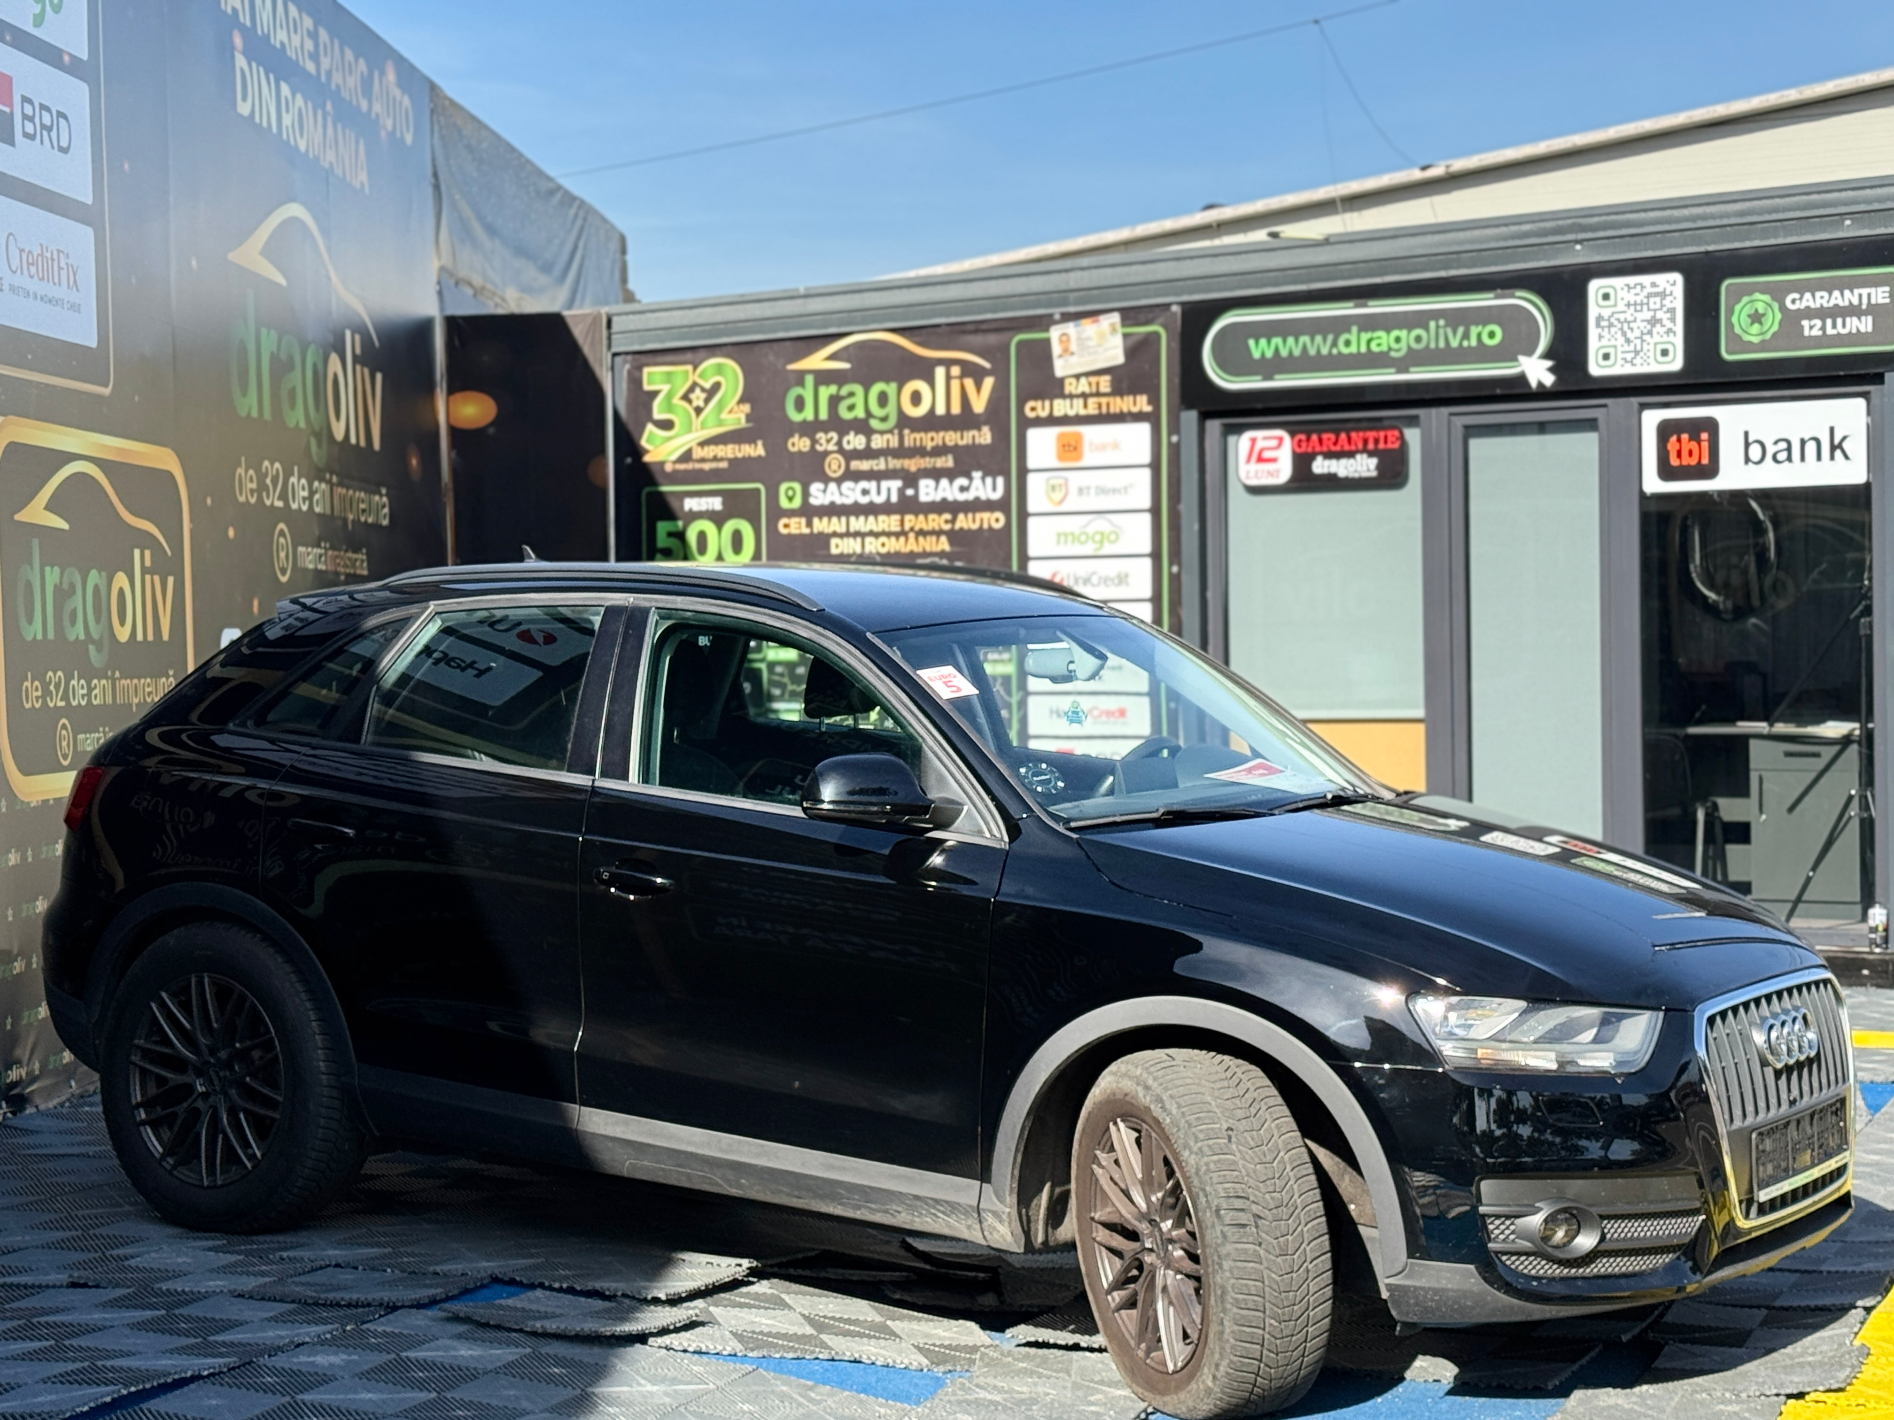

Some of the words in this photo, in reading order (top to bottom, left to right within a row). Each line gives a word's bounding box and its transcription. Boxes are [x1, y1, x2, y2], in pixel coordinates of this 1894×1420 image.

[220, 0, 250, 27] AI
[255, 0, 316, 76] MARE
[318, 26, 368, 113] PARC
[371, 70, 413, 146] AUTO
[21, 94, 72, 155] BRD
[235, 51, 277, 134] DIN
[280, 80, 369, 195] ROMÂNIA
[5, 231, 80, 293] CreditFix
[1785, 286, 1891, 310] GARANȚIE
[1248, 319, 1503, 359] www.dragoliv.ro
[1801, 319, 1823, 336] 12
[1826, 315, 1873, 335] LUNI
[229, 288, 382, 468] dragoliv
[1064, 375, 1111, 395] RATE
[641, 357, 745, 451] 32
[785, 366, 995, 431] dragoliv
[1024, 399, 1050, 418] CU
[1052, 394, 1153, 417] BULETINUL
[787, 433, 811, 452] de
[815, 431, 838, 451] 32
[842, 431, 867, 450] de
[870, 429, 899, 449] ani
[903, 426, 992, 451] împreună
[1245, 436, 1284, 464] 12
[1292, 429, 1402, 454] GARANTIE
[1667, 431, 1710, 466] tbi
[1743, 426, 1852, 466] bank
[850, 457, 885, 471] marcă
[1245, 468, 1281, 480] LUNI
[1312, 453, 1379, 478] dragoliv
[235, 456, 257, 504] de
[262, 460, 284, 508] 32
[288, 465, 309, 511] de
[313, 473, 331, 515] ani
[332, 474, 389, 530] împreună
[809, 480, 902, 505] SASCUT
[918, 471, 1004, 502] BACĂU
[683, 496, 723, 512] PESTE
[777, 517, 810, 535] CEL
[813, 516, 846, 533] MAI
[850, 514, 901, 532] MARE
[904, 512, 952, 531] PARC
[955, 511, 1005, 530] AUTO
[654, 518, 756, 563] 500
[830, 537, 863, 554] DIN
[864, 532, 950, 553] ROMÂNIA
[1055, 530, 1120, 553] mogo
[1066, 571, 1130, 587] UniCredit
[16, 538, 174, 667] dragoliv
[22, 672, 42, 709] de
[46, 671, 66, 707] 32
[69, 671, 88, 706] de
[91, 671, 113, 705] ani
[942, 680, 962, 693] 5
